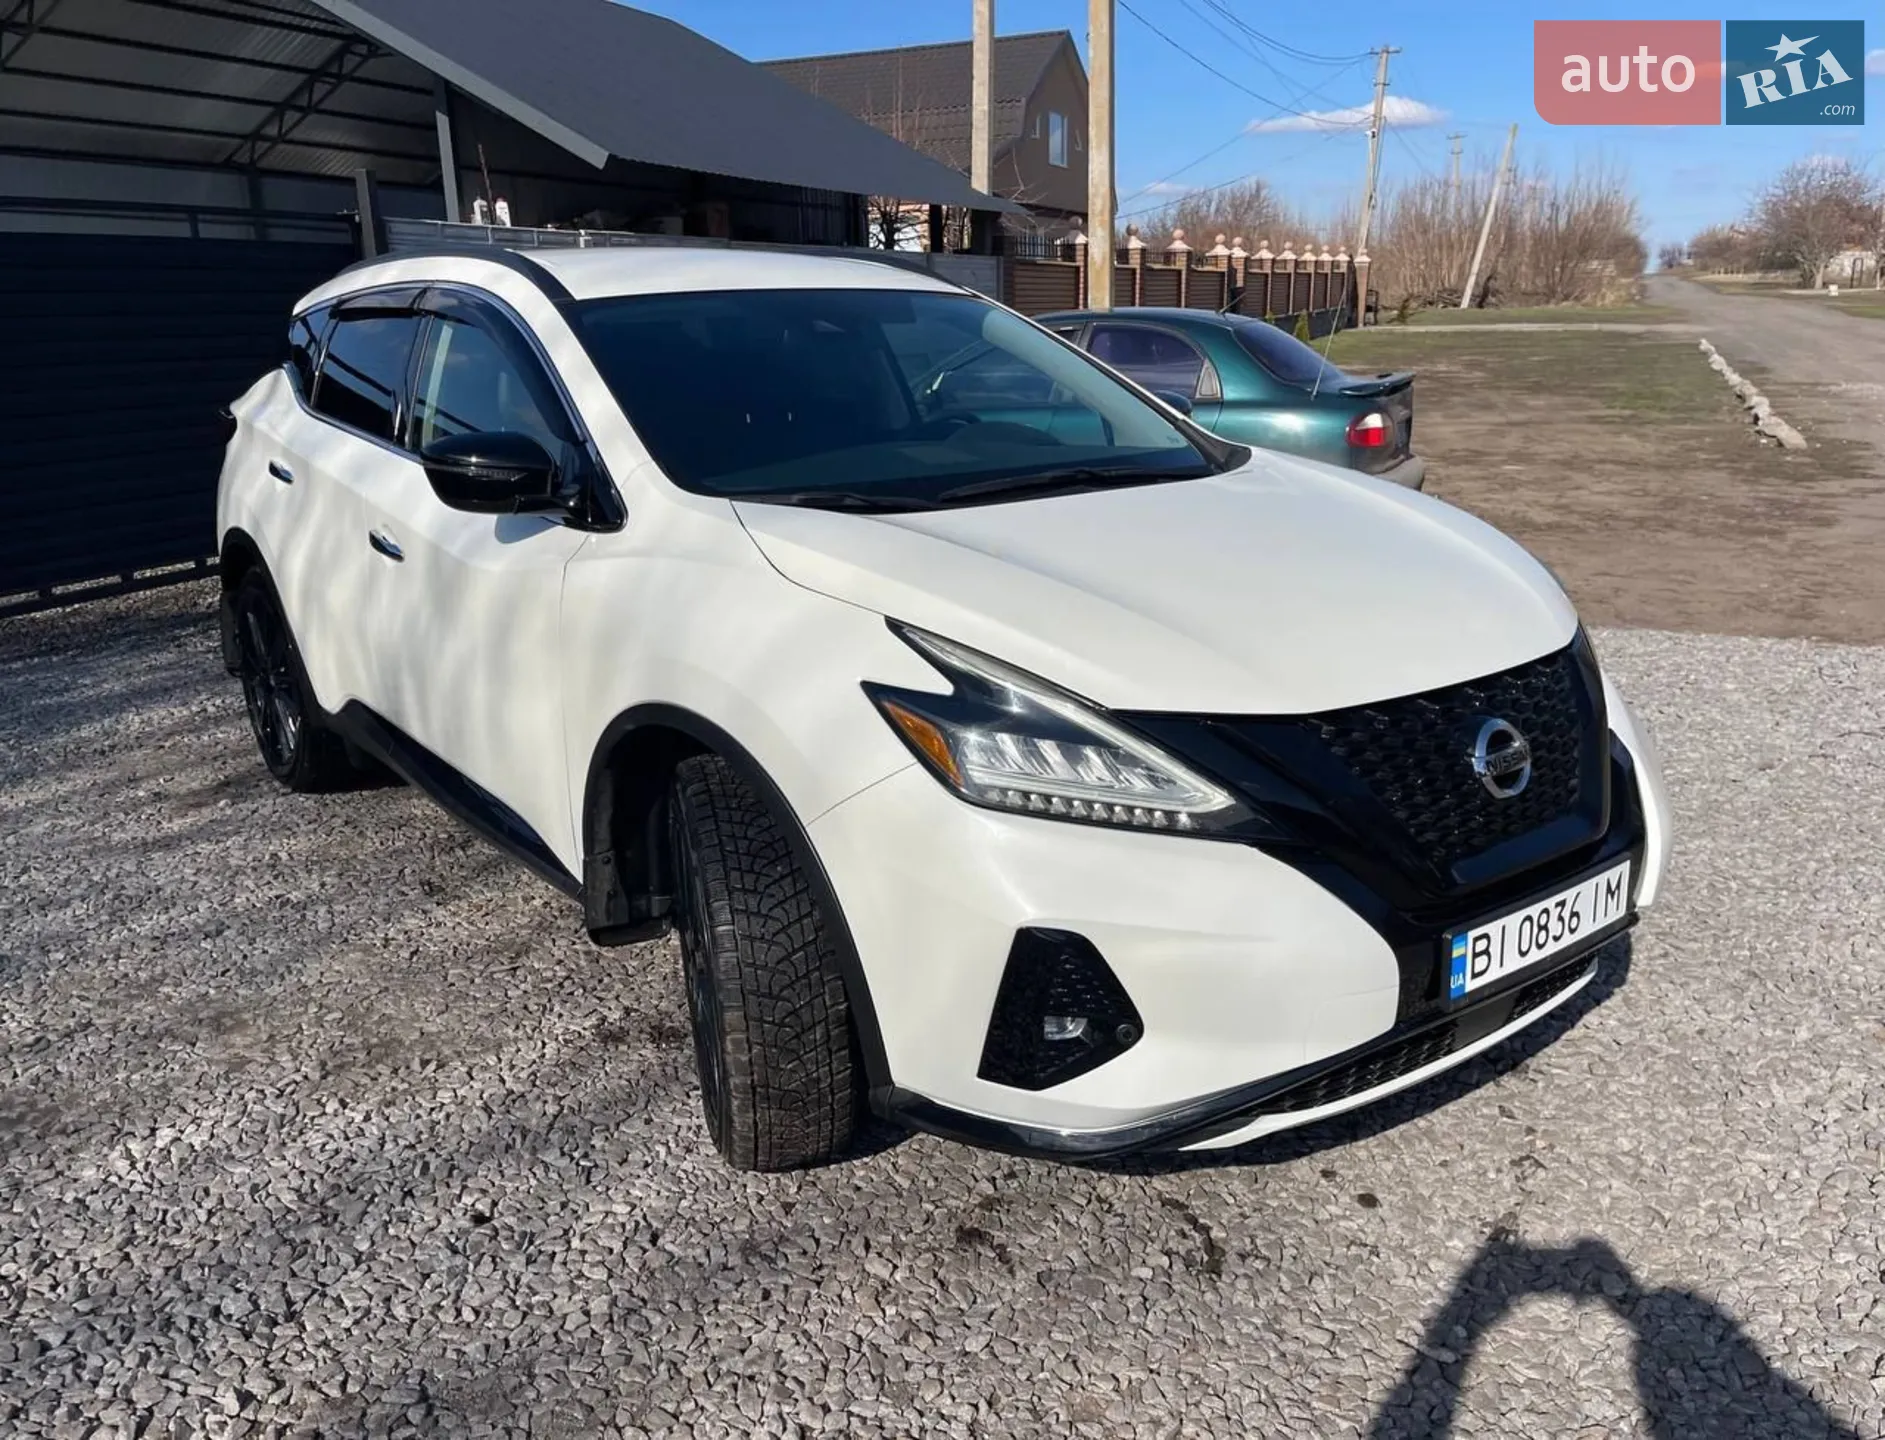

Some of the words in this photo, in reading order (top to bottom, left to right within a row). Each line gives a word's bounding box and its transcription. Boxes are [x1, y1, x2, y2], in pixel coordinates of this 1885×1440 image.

[1470, 924, 1506, 980] BI
[1518, 891, 1582, 958] 0836
[1592, 871, 1623, 925] IM
[1450, 972, 1464, 989] UA
